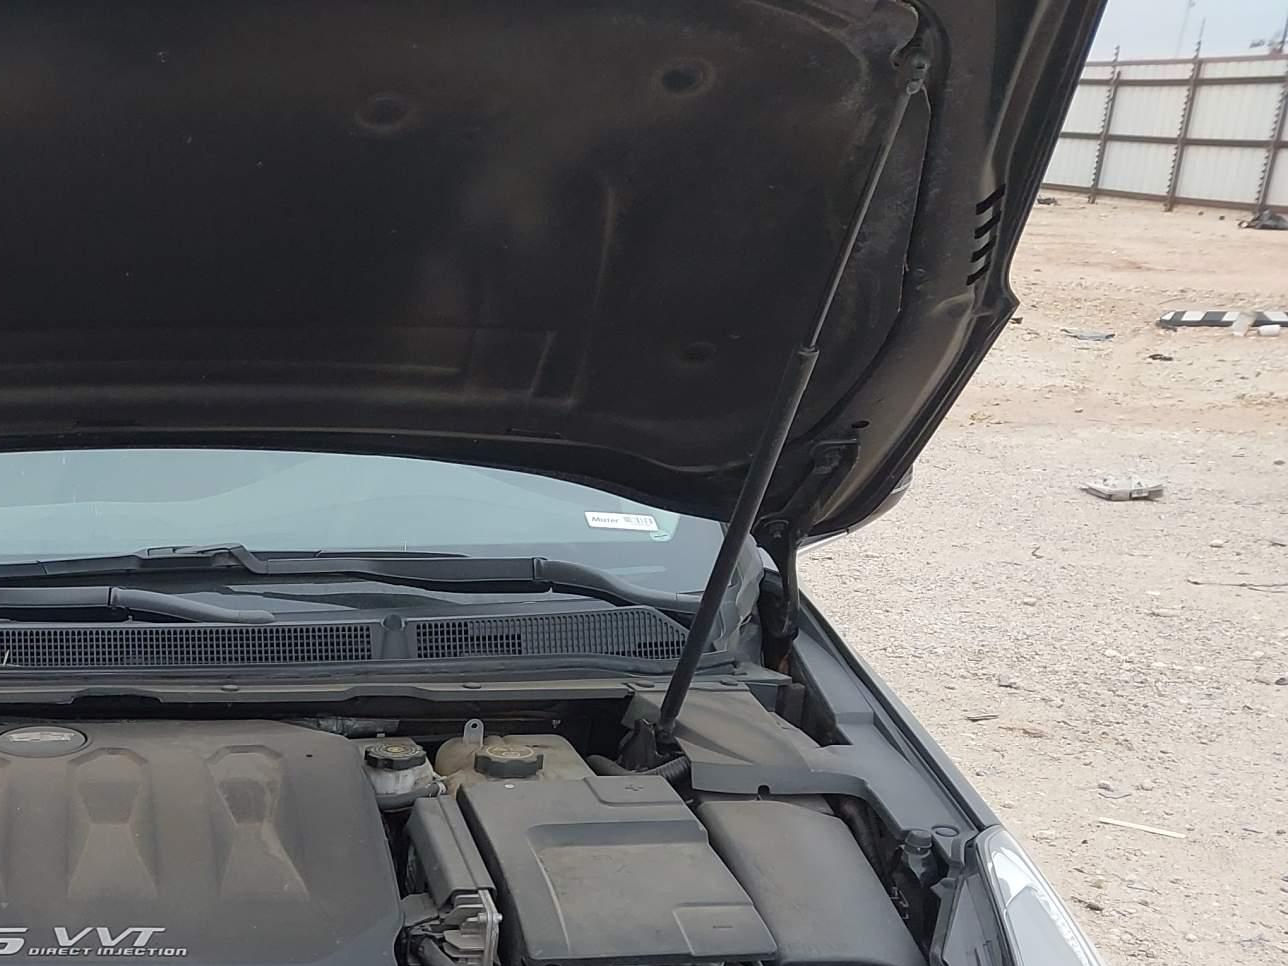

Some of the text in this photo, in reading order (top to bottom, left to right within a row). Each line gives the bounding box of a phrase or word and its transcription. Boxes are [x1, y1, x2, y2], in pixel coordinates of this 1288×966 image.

[54, 926, 166, 948] VVT
[28, 947, 187, 956] DIRECT INJECTION
